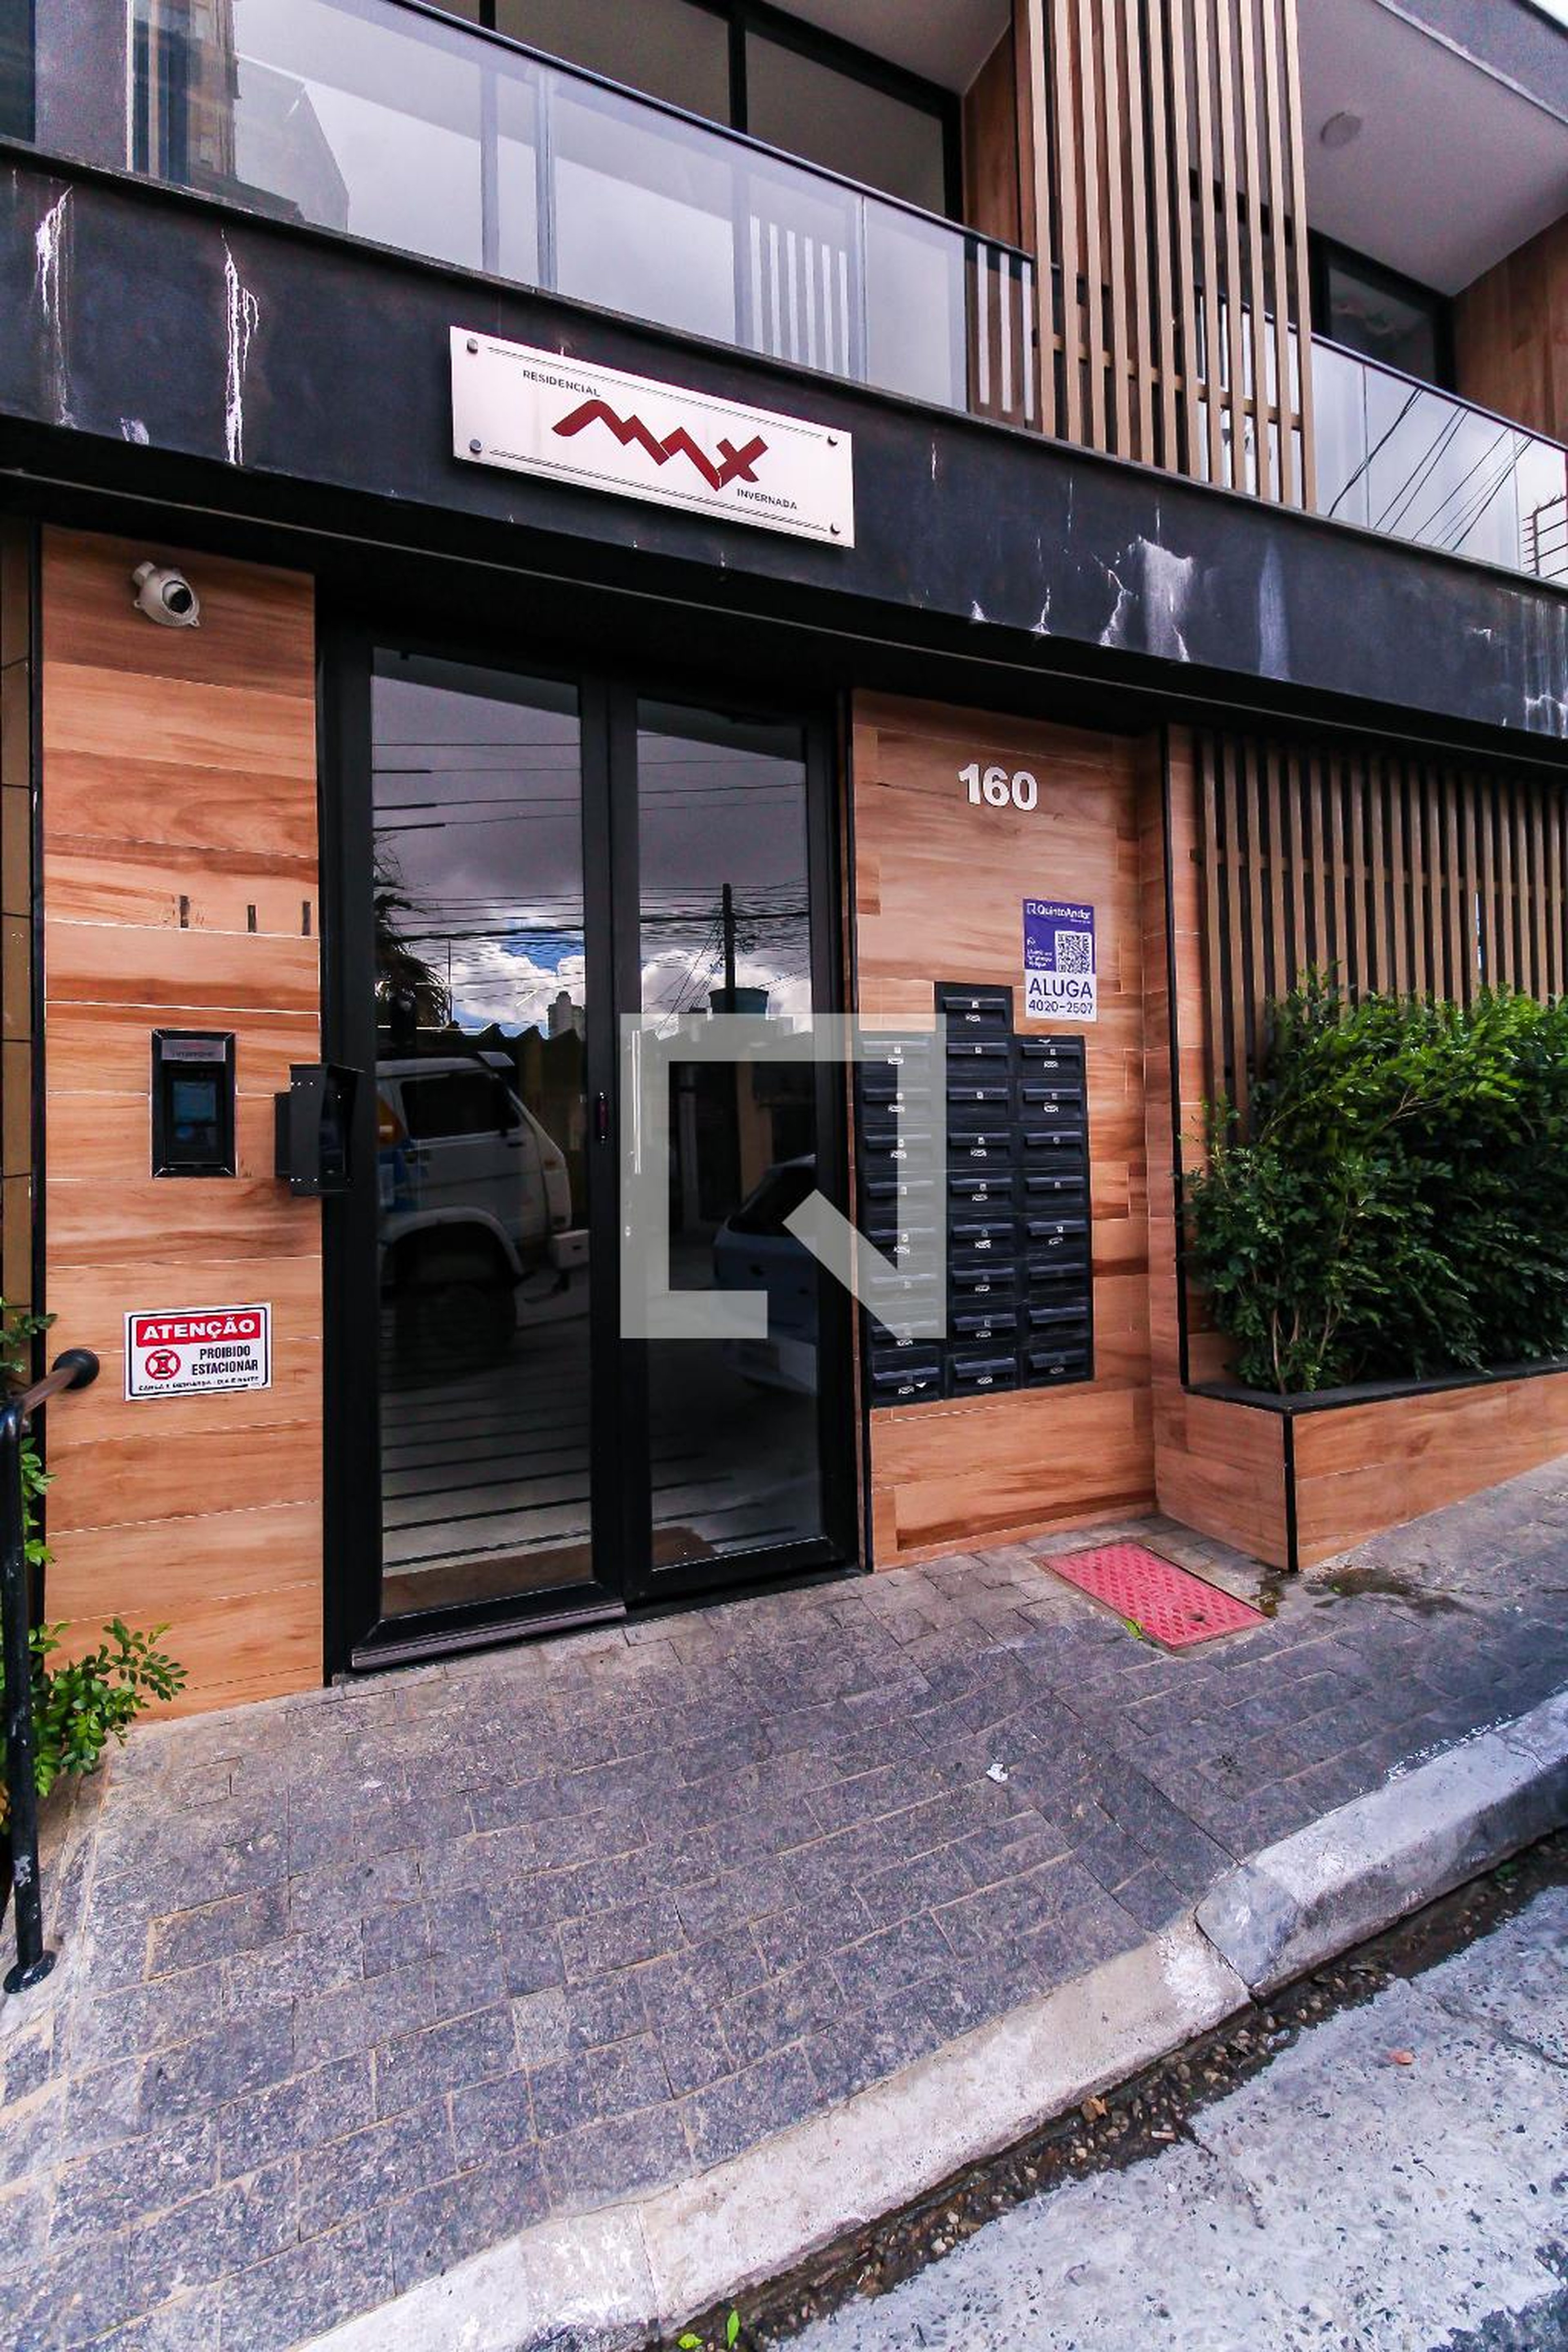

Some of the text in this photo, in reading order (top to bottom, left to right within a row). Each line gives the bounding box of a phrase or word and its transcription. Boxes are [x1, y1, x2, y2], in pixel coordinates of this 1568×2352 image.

[523, 370, 601, 397] RESIDENCIAL
[737, 488, 797, 509] INVERNADA
[958, 764, 1038, 811] 160
[1029, 978, 1093, 999] ALUGA
[1029, 999, 1093, 1014] 4020-2507
[143, 1316, 255, 1340] ATENÇÃO
[199, 1345, 251, 1360] PROIBIDO
[192, 1359, 258, 1376] ESTACIONAR
